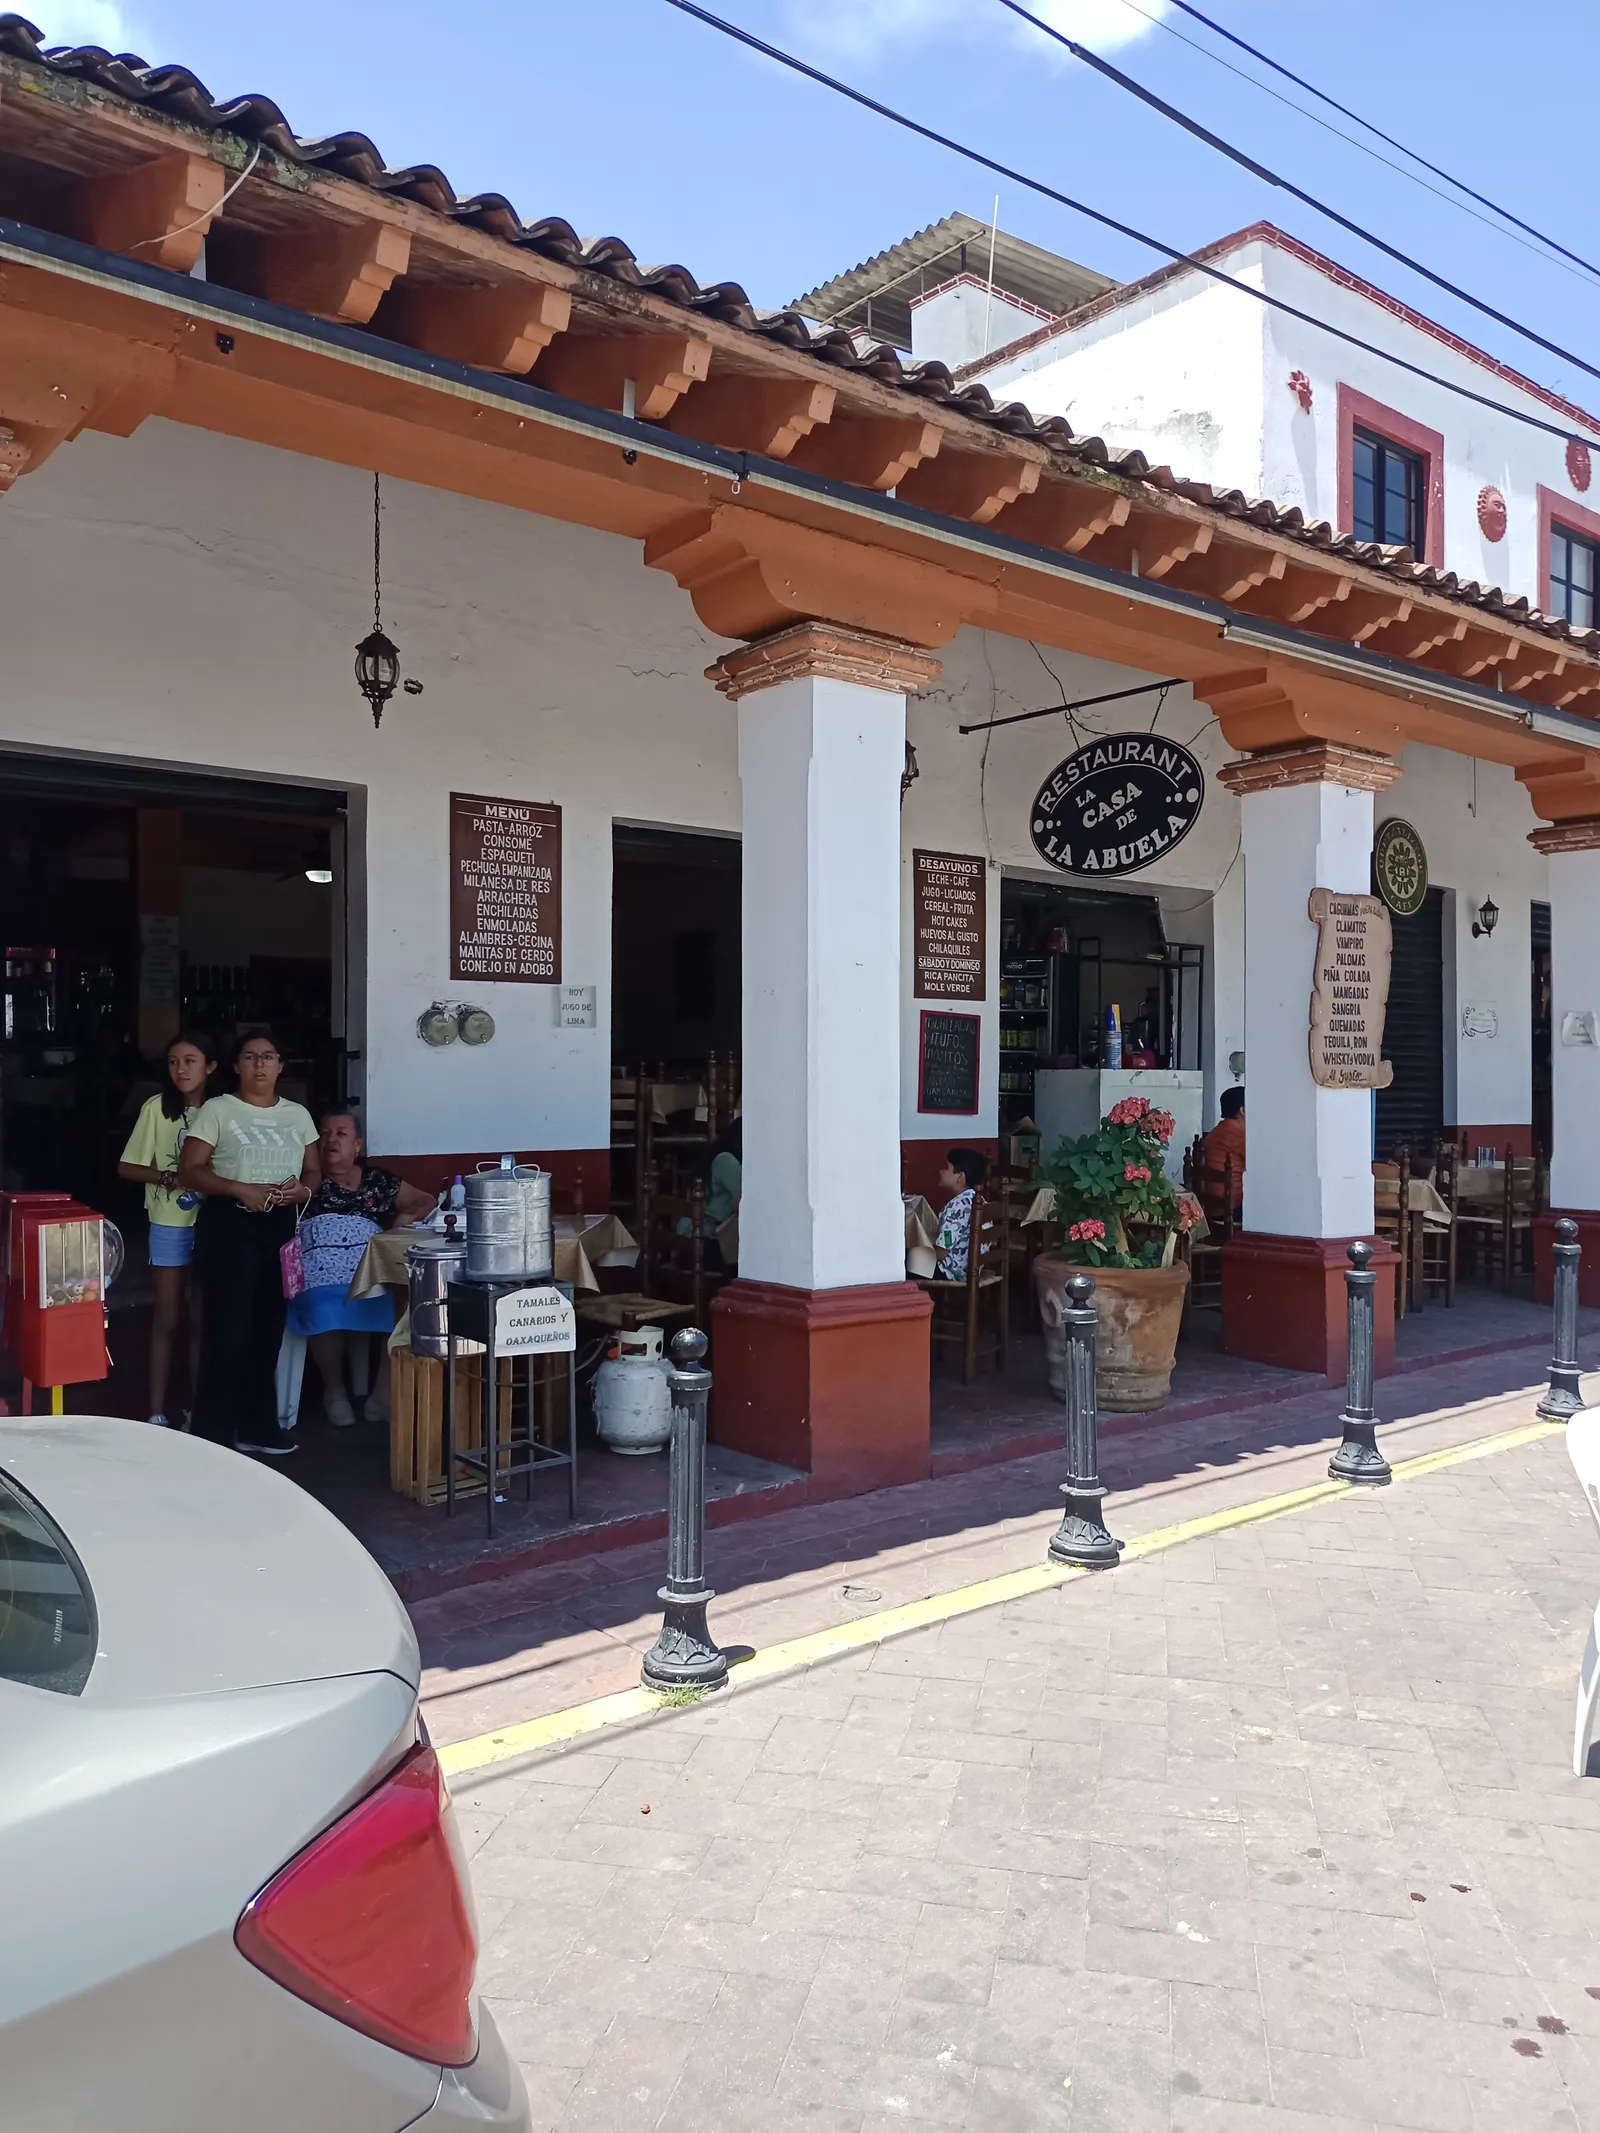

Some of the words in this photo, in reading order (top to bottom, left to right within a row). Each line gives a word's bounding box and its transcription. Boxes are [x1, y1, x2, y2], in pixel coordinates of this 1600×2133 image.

[1038, 741, 1192, 812] RESTAURANT
[1075, 789, 1096, 808] LA
[1082, 782, 1143, 828] CASA
[486, 805, 530, 820] MENÚ
[1115, 808, 1138, 830] DE
[484, 834, 532, 850] CONSOMÉ
[1044, 836, 1072, 866] LA
[1082, 815, 1188, 869] ABUELA
[481, 848, 535, 864] ESPAGUETI
[461, 860, 500, 875] PECHUGA
[502, 864, 552, 880] EMPANIZADA
[920, 858, 978, 874] DESAYUNOS
[464, 874, 514, 890] MILANESA
[516, 879, 528, 891] DE
[532, 880, 550, 893] RES
[478, 890, 538, 906] ARRACHERA
[477, 904, 539, 919] ENCHILADAS
[477, 918, 537, 933] ENMOLADAS
[932, 915, 945, 926] HOT
[946, 916, 967, 928] CAKES
[1336, 920, 1367, 933] CLAMATOS
[459, 931, 554, 949] ALAMBRES-CECINA
[920, 928, 946, 940] HUEVOS
[947, 930, 956, 940] AL
[956, 931, 978, 942] GUSTO
[928, 943, 970, 956] CHILAQUILES
[1336, 936, 1364, 950] VAMPIRO
[460, 946, 503, 959] MANITAS
[506, 948, 517, 959] DE
[521, 949, 554, 962] CERDO
[1336, 953, 1366, 966] PALOMAS
[460, 960, 501, 973] CONEJO
[504, 962, 516, 973] EN
[519, 962, 553, 976] ADOBO
[946, 960, 950, 968] Y
[950, 960, 980, 970] DOMINGO
[924, 972, 942, 980] RICA
[944, 972, 974, 982] PANCITA
[1324, 966, 1340, 982] PIÑA
[1344, 970, 1371, 983] COLADA
[569, 988, 584, 996] HOY
[924, 982, 945, 991] MOLE
[946, 984, 970, 993] VERDE
[1333, 986, 1369, 1000] MANGADAS
[1332, 1003, 1361, 1015] SANGRIA
[1329, 1019, 1365, 1032] QUEMADAS
[1324, 1036, 1353, 1050] TEQUILA,
[1354, 1036, 1368, 1048] RON
[1322, 1052, 1350, 1065] WHISKY
[1353, 1053, 1376, 1066] VODKA
[517, 1296, 560, 1308] TAMALES
[509, 1315, 556, 1327] CANARIOS
[561, 1312, 568, 1322] Y
[506, 1331, 570, 1346] OAXAQUEÑOS
